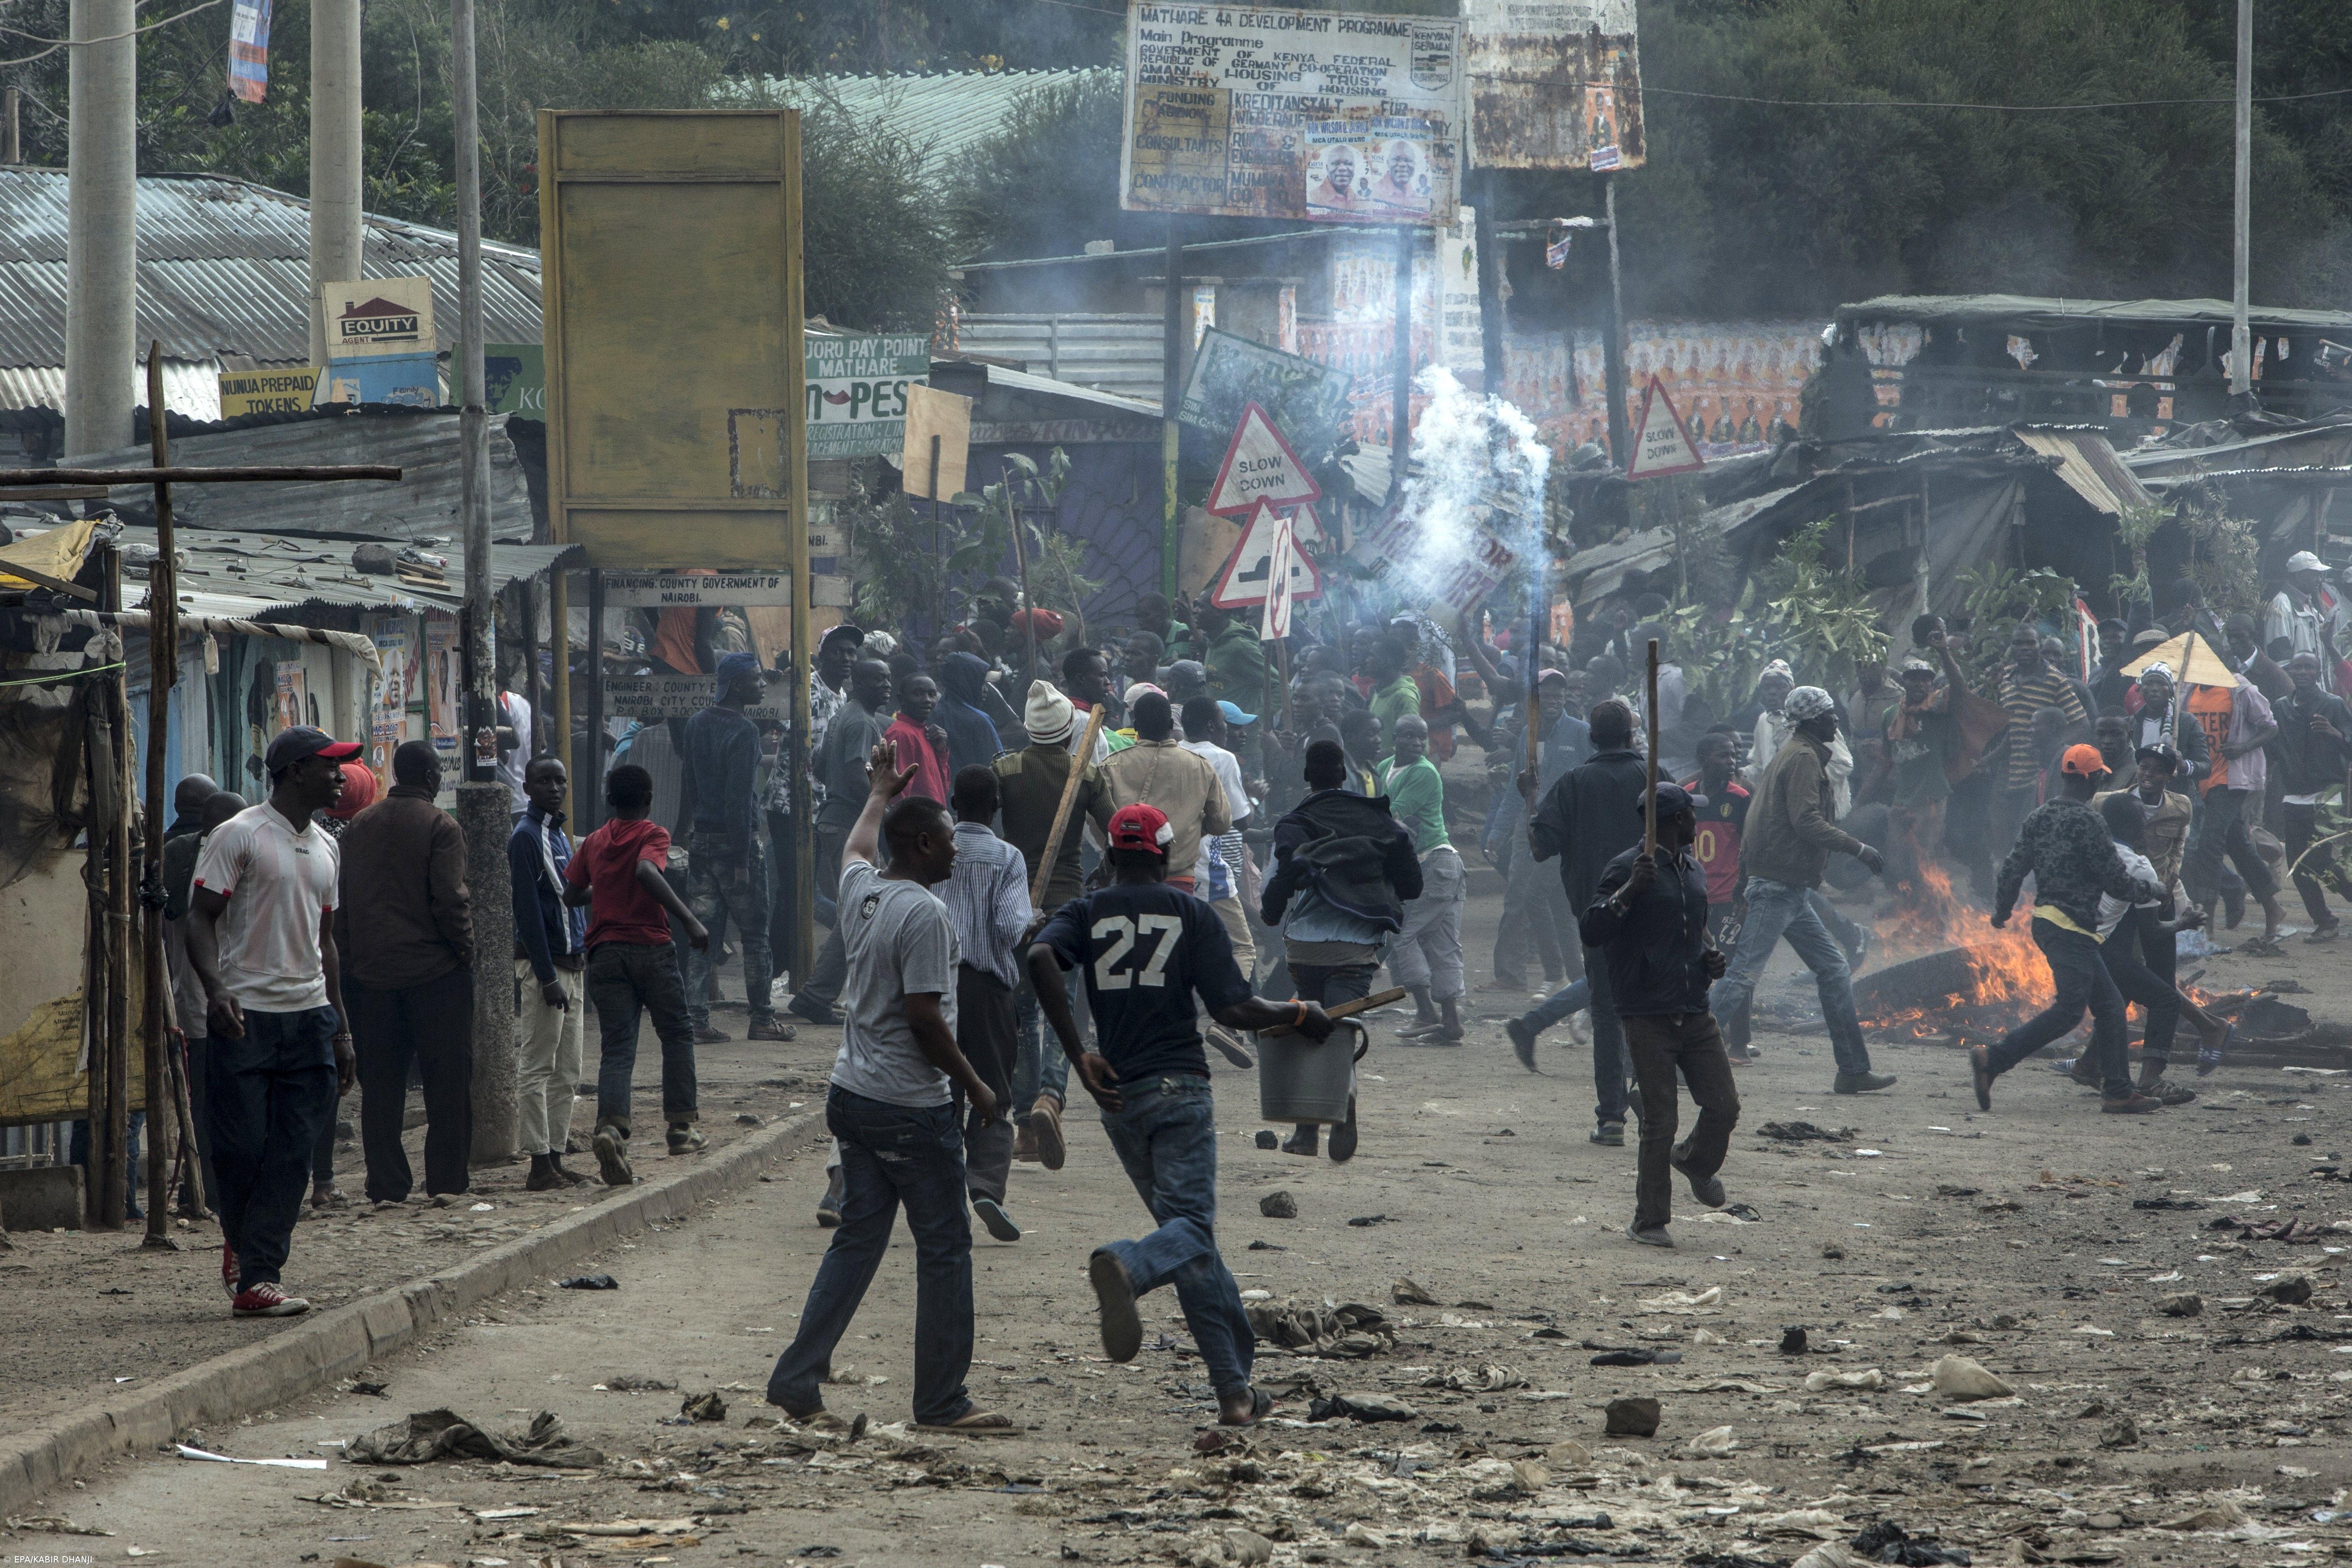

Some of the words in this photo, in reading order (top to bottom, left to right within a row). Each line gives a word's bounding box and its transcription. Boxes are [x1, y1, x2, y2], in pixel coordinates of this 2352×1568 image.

[1141, 8, 1208, 26] MATHARE
[1215, 11, 1232, 27] 4A
[1239, 14, 1332, 33] DEVELOPMENT
[1338, 20, 1412, 38] PROGRAMME
[1140, 28, 1172, 43] Main
[1140, 44, 1220, 57] GOVERMENT
[1236, 50, 1255, 59] OF
[1333, 54, 1396, 68] FEDERAL
[1140, 54, 1195, 66] REPUBLIC
[1202, 58, 1220, 67] OF
[1231, 59, 1288, 71] GERMANY
[1140, 64, 1191, 77] AMANI
[1225, 68, 1302, 82] HOUSING
[1327, 74, 1382, 86] TRUST
[1139, 74, 1220, 88] MINISTRY
[1256, 81, 1280, 91] OF
[1318, 84, 1387, 97] HOUSING
[1157, 92, 1215, 106] FUNDING
[1235, 92, 1343, 114] KREDITANSTALT
[344, 317, 414, 334] EQUITY
[342, 336, 369, 344] AGENT
[848, 338, 880, 358] PAY
[883, 338, 928, 357] POINT
[818, 358, 898, 377] MATHARE
[2313, 357, 2331, 368] POLICE
[220, 377, 261, 396] NUNUA
[261, 375, 314, 393] PREPAID
[246, 397, 302, 415] TOKENS
[1183, 399, 1201, 413] SIM
[1179, 410, 1198, 424] SIM
[807, 423, 875, 441] REGISTRATION
[1646, 426, 1675, 443] SLOW
[864, 437, 903, 452] SCRATCH
[1646, 443, 1677, 460] DOWN
[1239, 455, 1282, 474] SLOW
[1240, 474, 1285, 492] DOWN
[660, 578, 697, 589] COUNTY
[702, 577, 766, 589] GOVERNMENT
[768, 577, 779, 589] OF
[661, 592, 702, 603] NAIROBI.
[605, 681, 652, 692] ENGINEER
[663, 681, 706, 692] COUNTY
[614, 695, 653, 706] NAIROBI
[661, 696, 686, 706] CITY
[641, 706, 664, 716] BOX
[1091, 913, 1183, 990] 27
